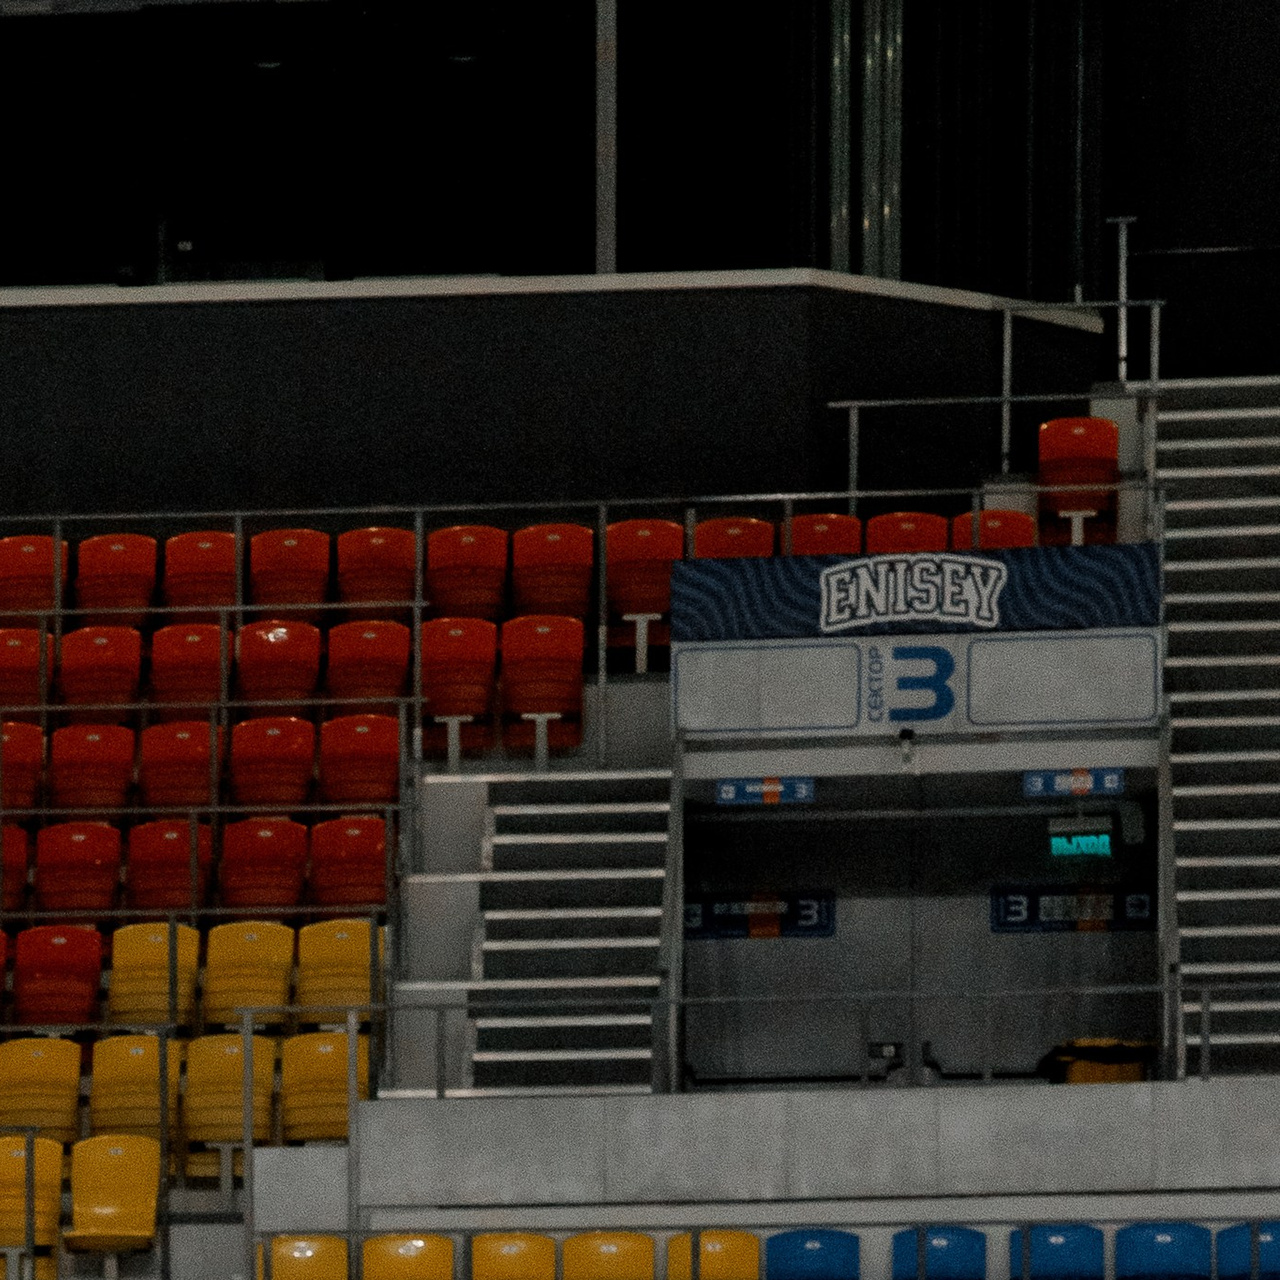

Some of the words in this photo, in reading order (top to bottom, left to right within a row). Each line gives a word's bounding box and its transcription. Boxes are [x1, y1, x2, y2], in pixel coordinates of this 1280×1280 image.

[822, 554, 1006, 631] ENISEY
[889, 646, 955, 722] 3
[797, 899, 819, 926] 3
[1006, 895, 1029, 922] 3
